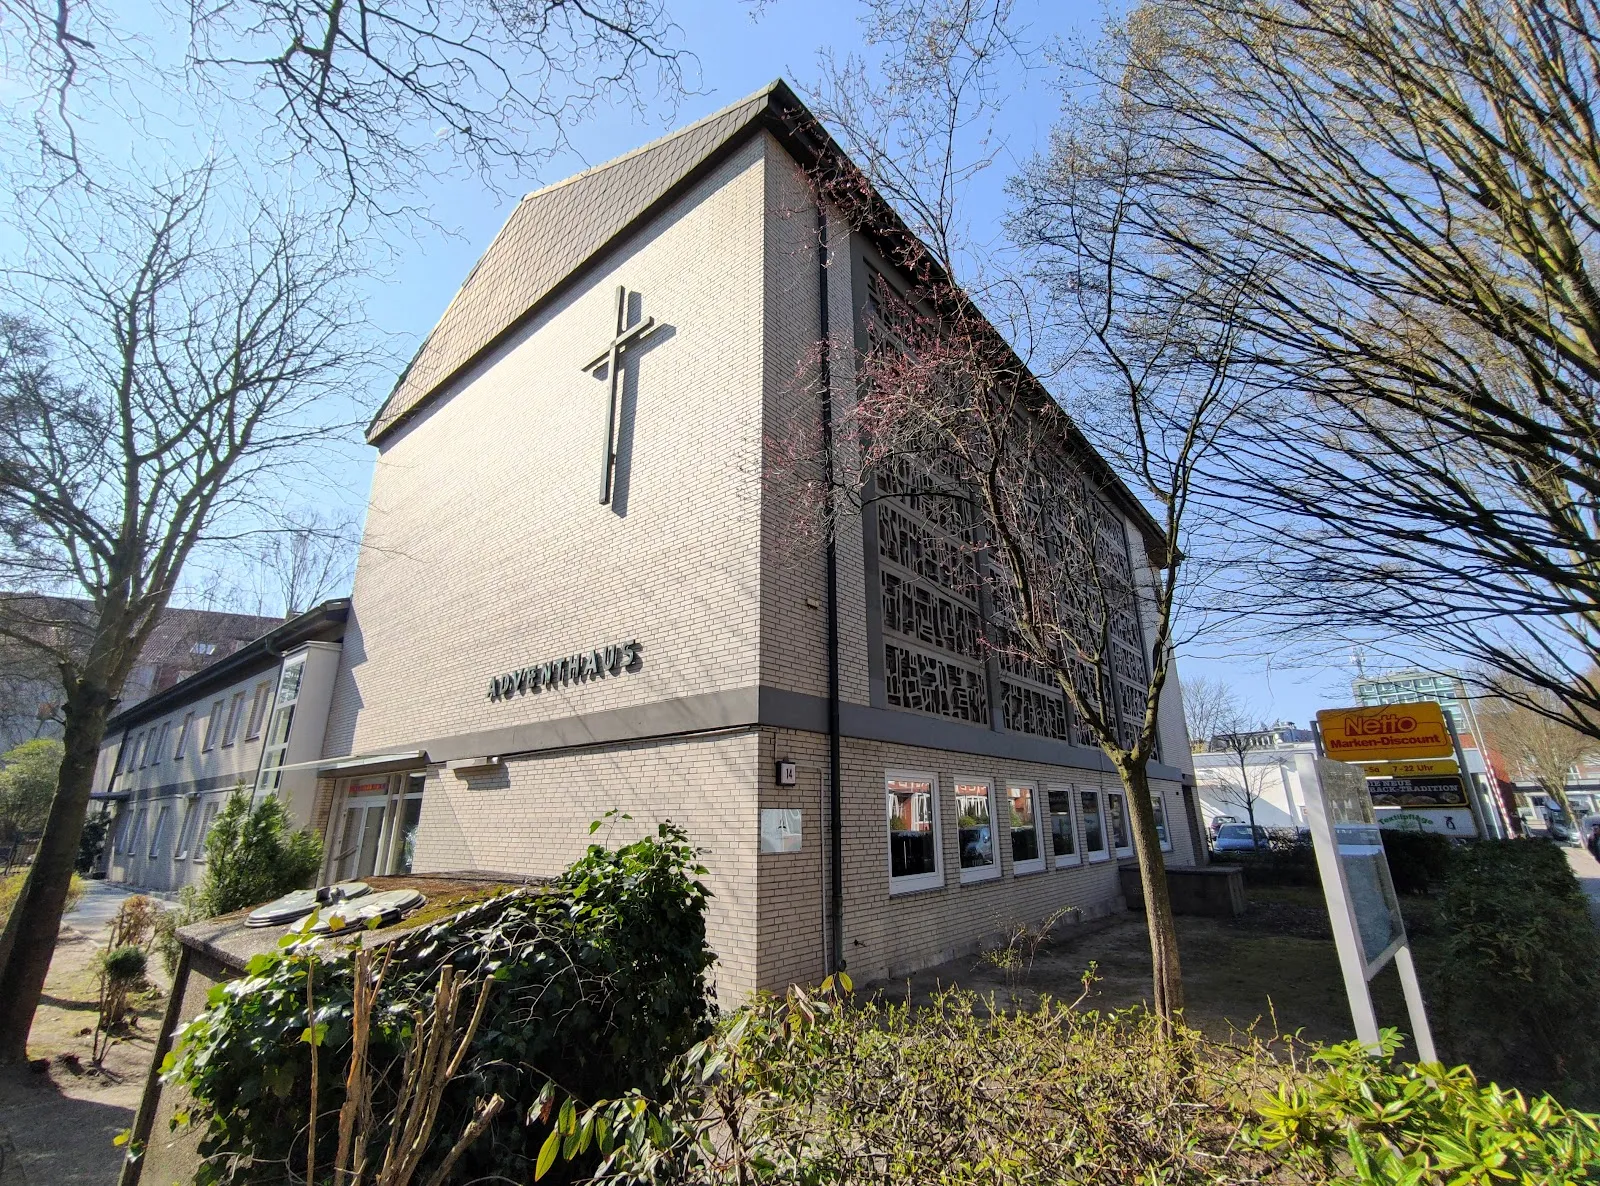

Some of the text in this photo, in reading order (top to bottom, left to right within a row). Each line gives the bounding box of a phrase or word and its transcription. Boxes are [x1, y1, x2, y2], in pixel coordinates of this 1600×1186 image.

[487, 639, 636, 698] ADVENTHAUS
[1345, 714, 1417, 736] Netto
[1330, 735, 1440, 748] Marken-Discount
[786, 768, 793, 779] 14
[1369, 784, 1459, 793] BACK-TRADITION
[1382, 779, 1412, 787] NEUE
